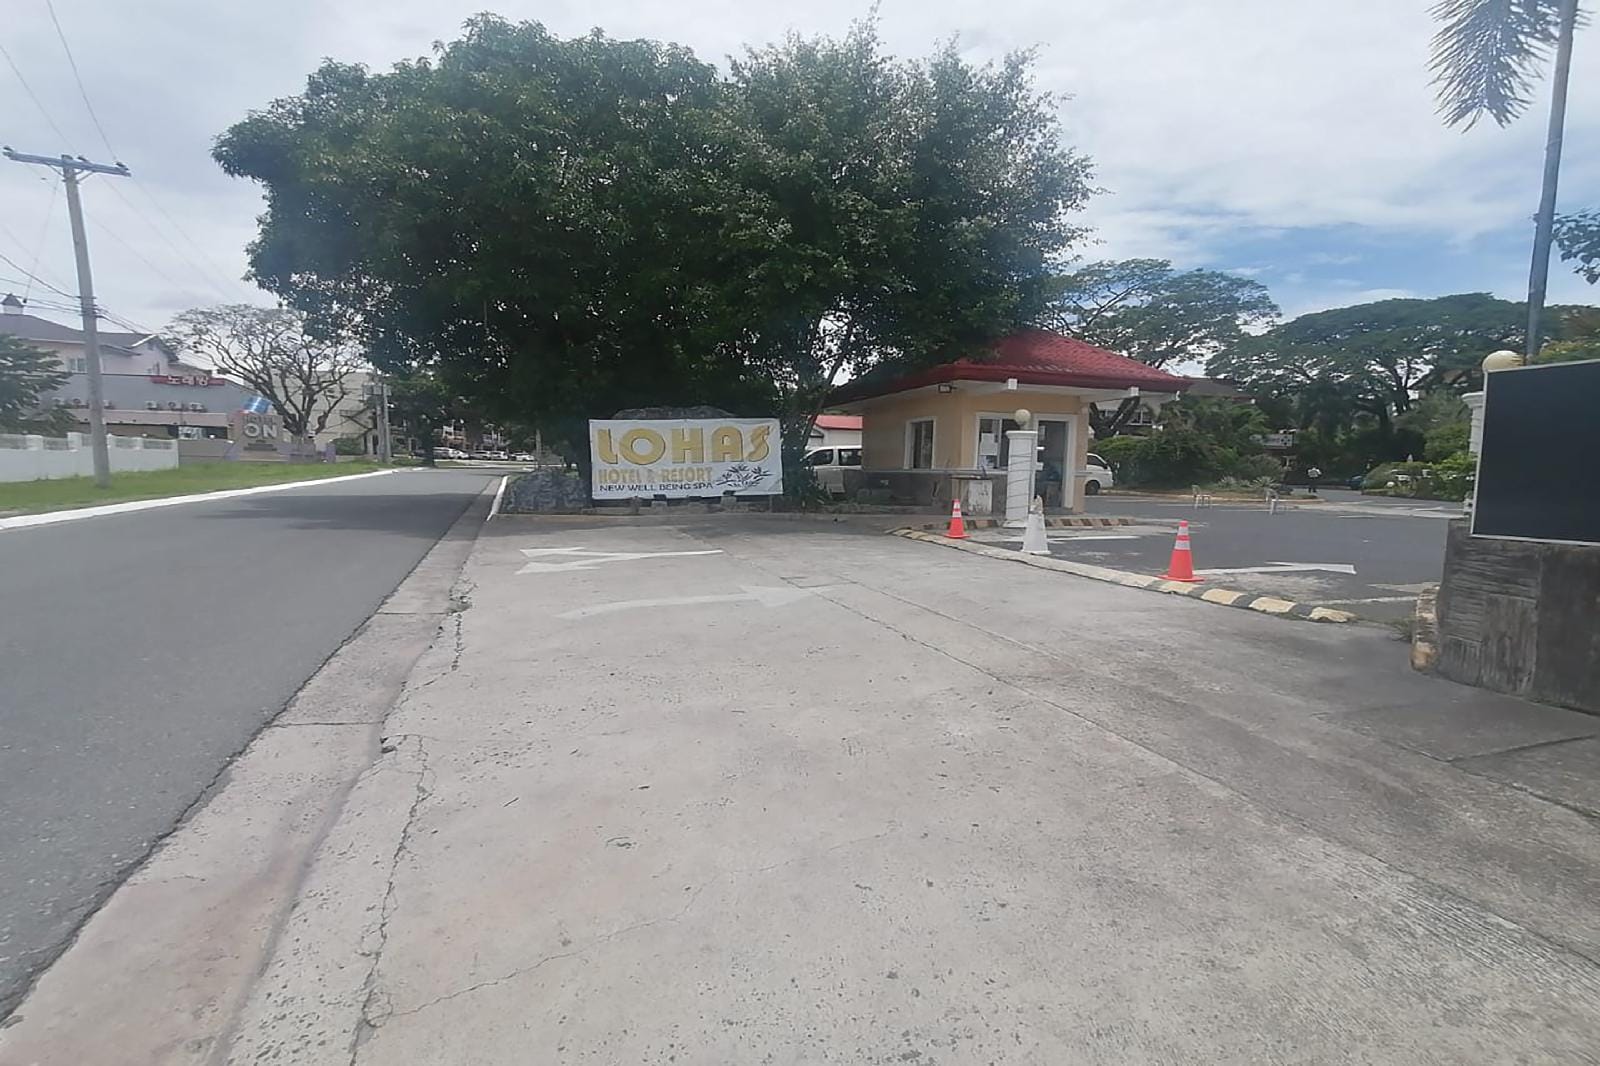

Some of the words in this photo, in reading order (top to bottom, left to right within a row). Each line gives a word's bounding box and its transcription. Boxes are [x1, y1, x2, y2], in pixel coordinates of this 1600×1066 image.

[244, 423, 277, 437] ON
[597, 425, 773, 465] LOHAS
[598, 468, 640, 483] HOTEL
[661, 466, 712, 482] RESORT
[599, 484, 625, 492] NEW
[659, 482, 692, 491] BEING
[693, 481, 714, 490] SPA
